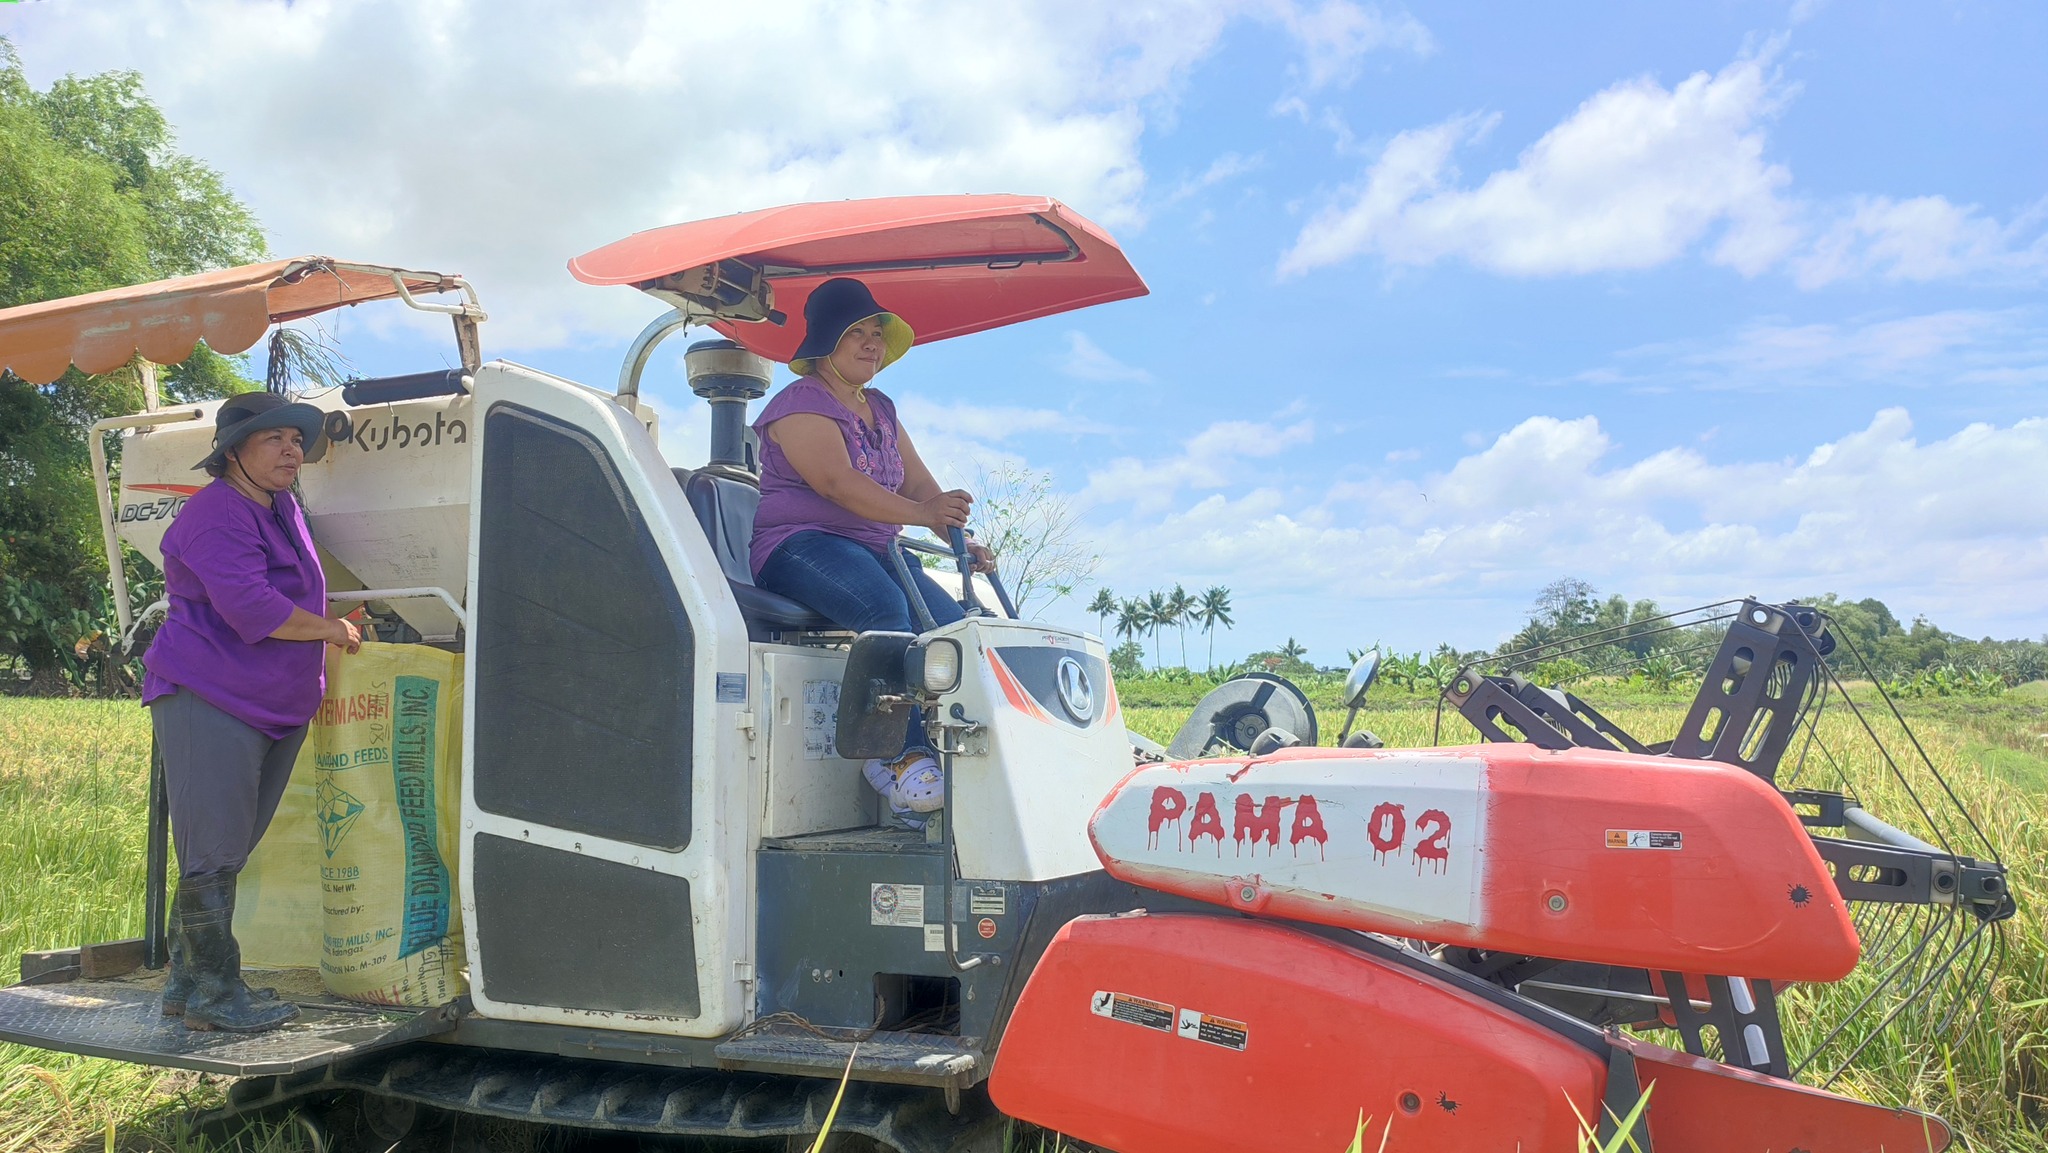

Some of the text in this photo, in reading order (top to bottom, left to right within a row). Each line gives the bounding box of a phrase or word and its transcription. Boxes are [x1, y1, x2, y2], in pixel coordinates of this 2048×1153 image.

[349, 411, 467, 452] Kubota
[354, 746, 389, 764] FEEDS
[399, 776, 426, 819] FEED
[1147, 785, 1453, 877] PAMA 02
[407, 822, 440, 896] DIAMOND
[333, 884, 344, 893] Net
[351, 904, 364, 915] by:
[345, 931, 372, 947] MILLS,
[375, 927, 396, 941] INC.
[344, 965, 358, 973] No.
[360, 954, 388, 970] M-309
[420, 980, 430, 1006] Mixer
[437, 976, 446, 999] Date:
[1133, 997, 1159, 1009] WARNING
[1216, 1019, 1242, 1029] WARNING
